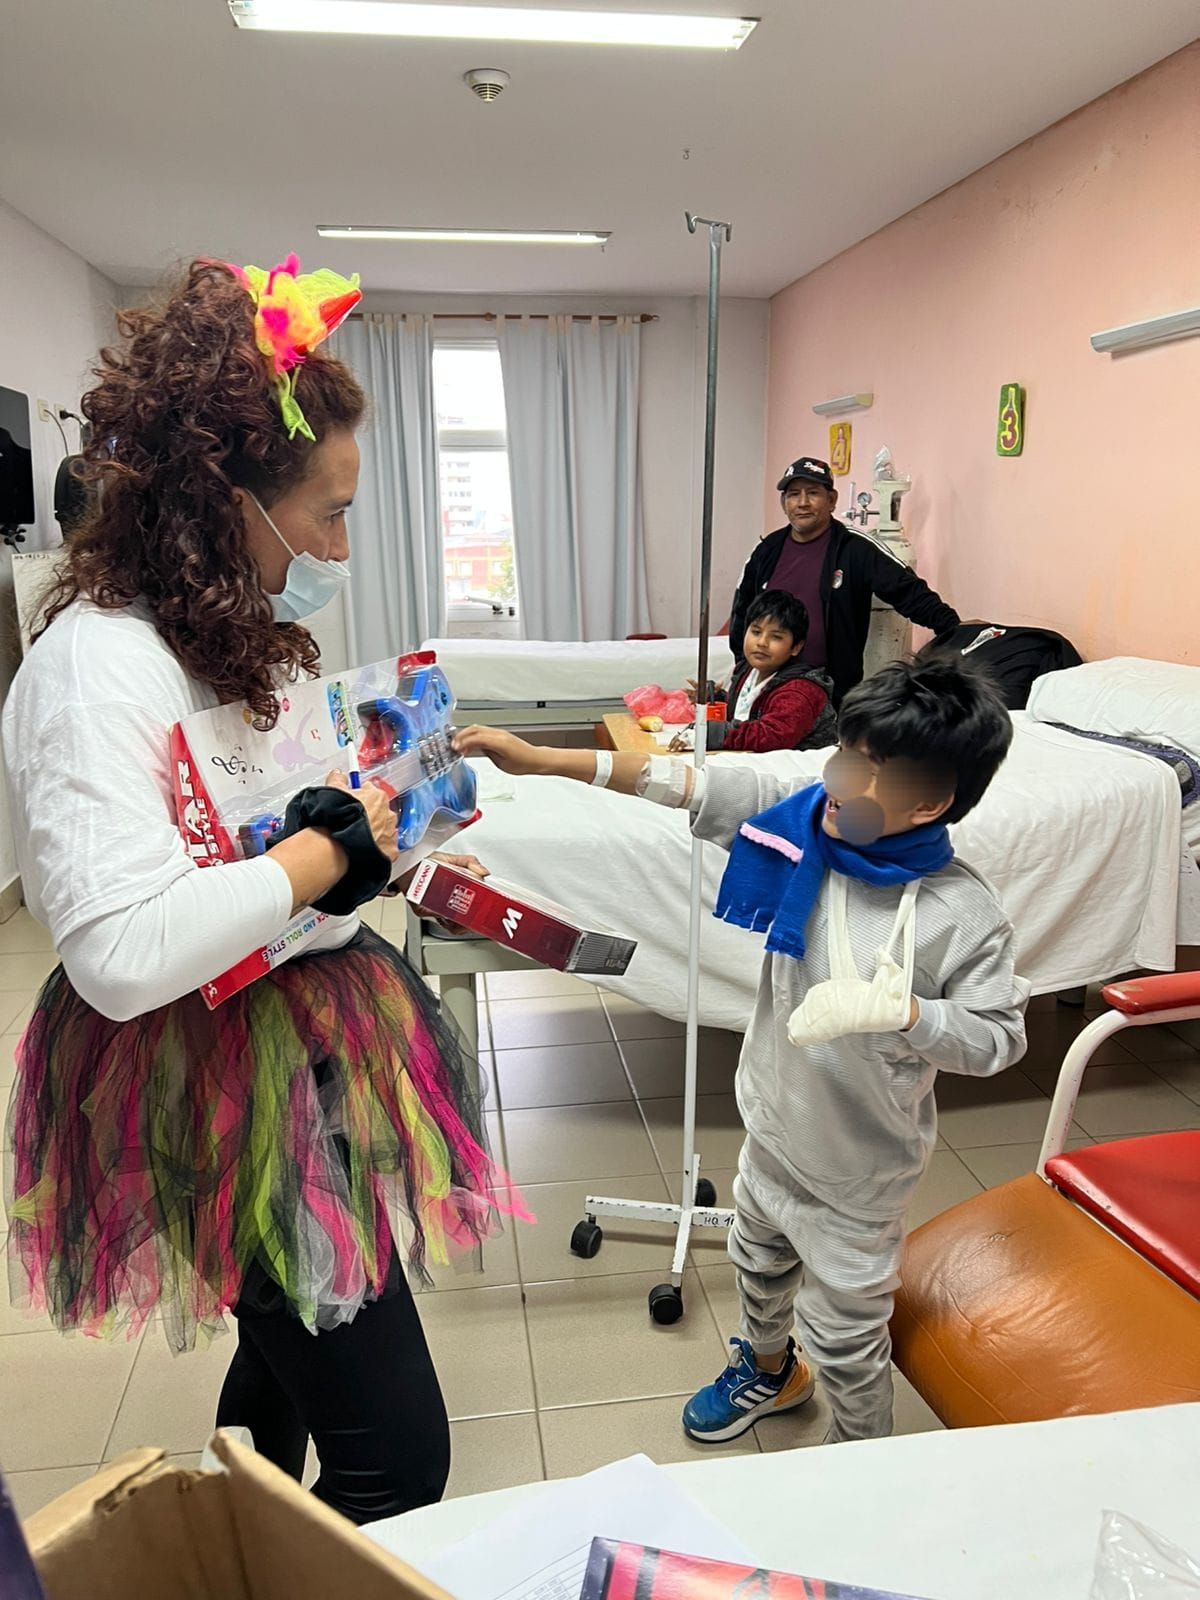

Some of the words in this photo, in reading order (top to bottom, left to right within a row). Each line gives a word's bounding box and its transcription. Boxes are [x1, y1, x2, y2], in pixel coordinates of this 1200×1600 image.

[1001, 408, 1019, 450] 3
[831, 437, 847, 470] 4
[197, 798, 220, 855] STYLE
[286, 928, 304, 944] ROLL
[302, 919, 317, 933] AND
[262, 939, 287, 961] STYLE
